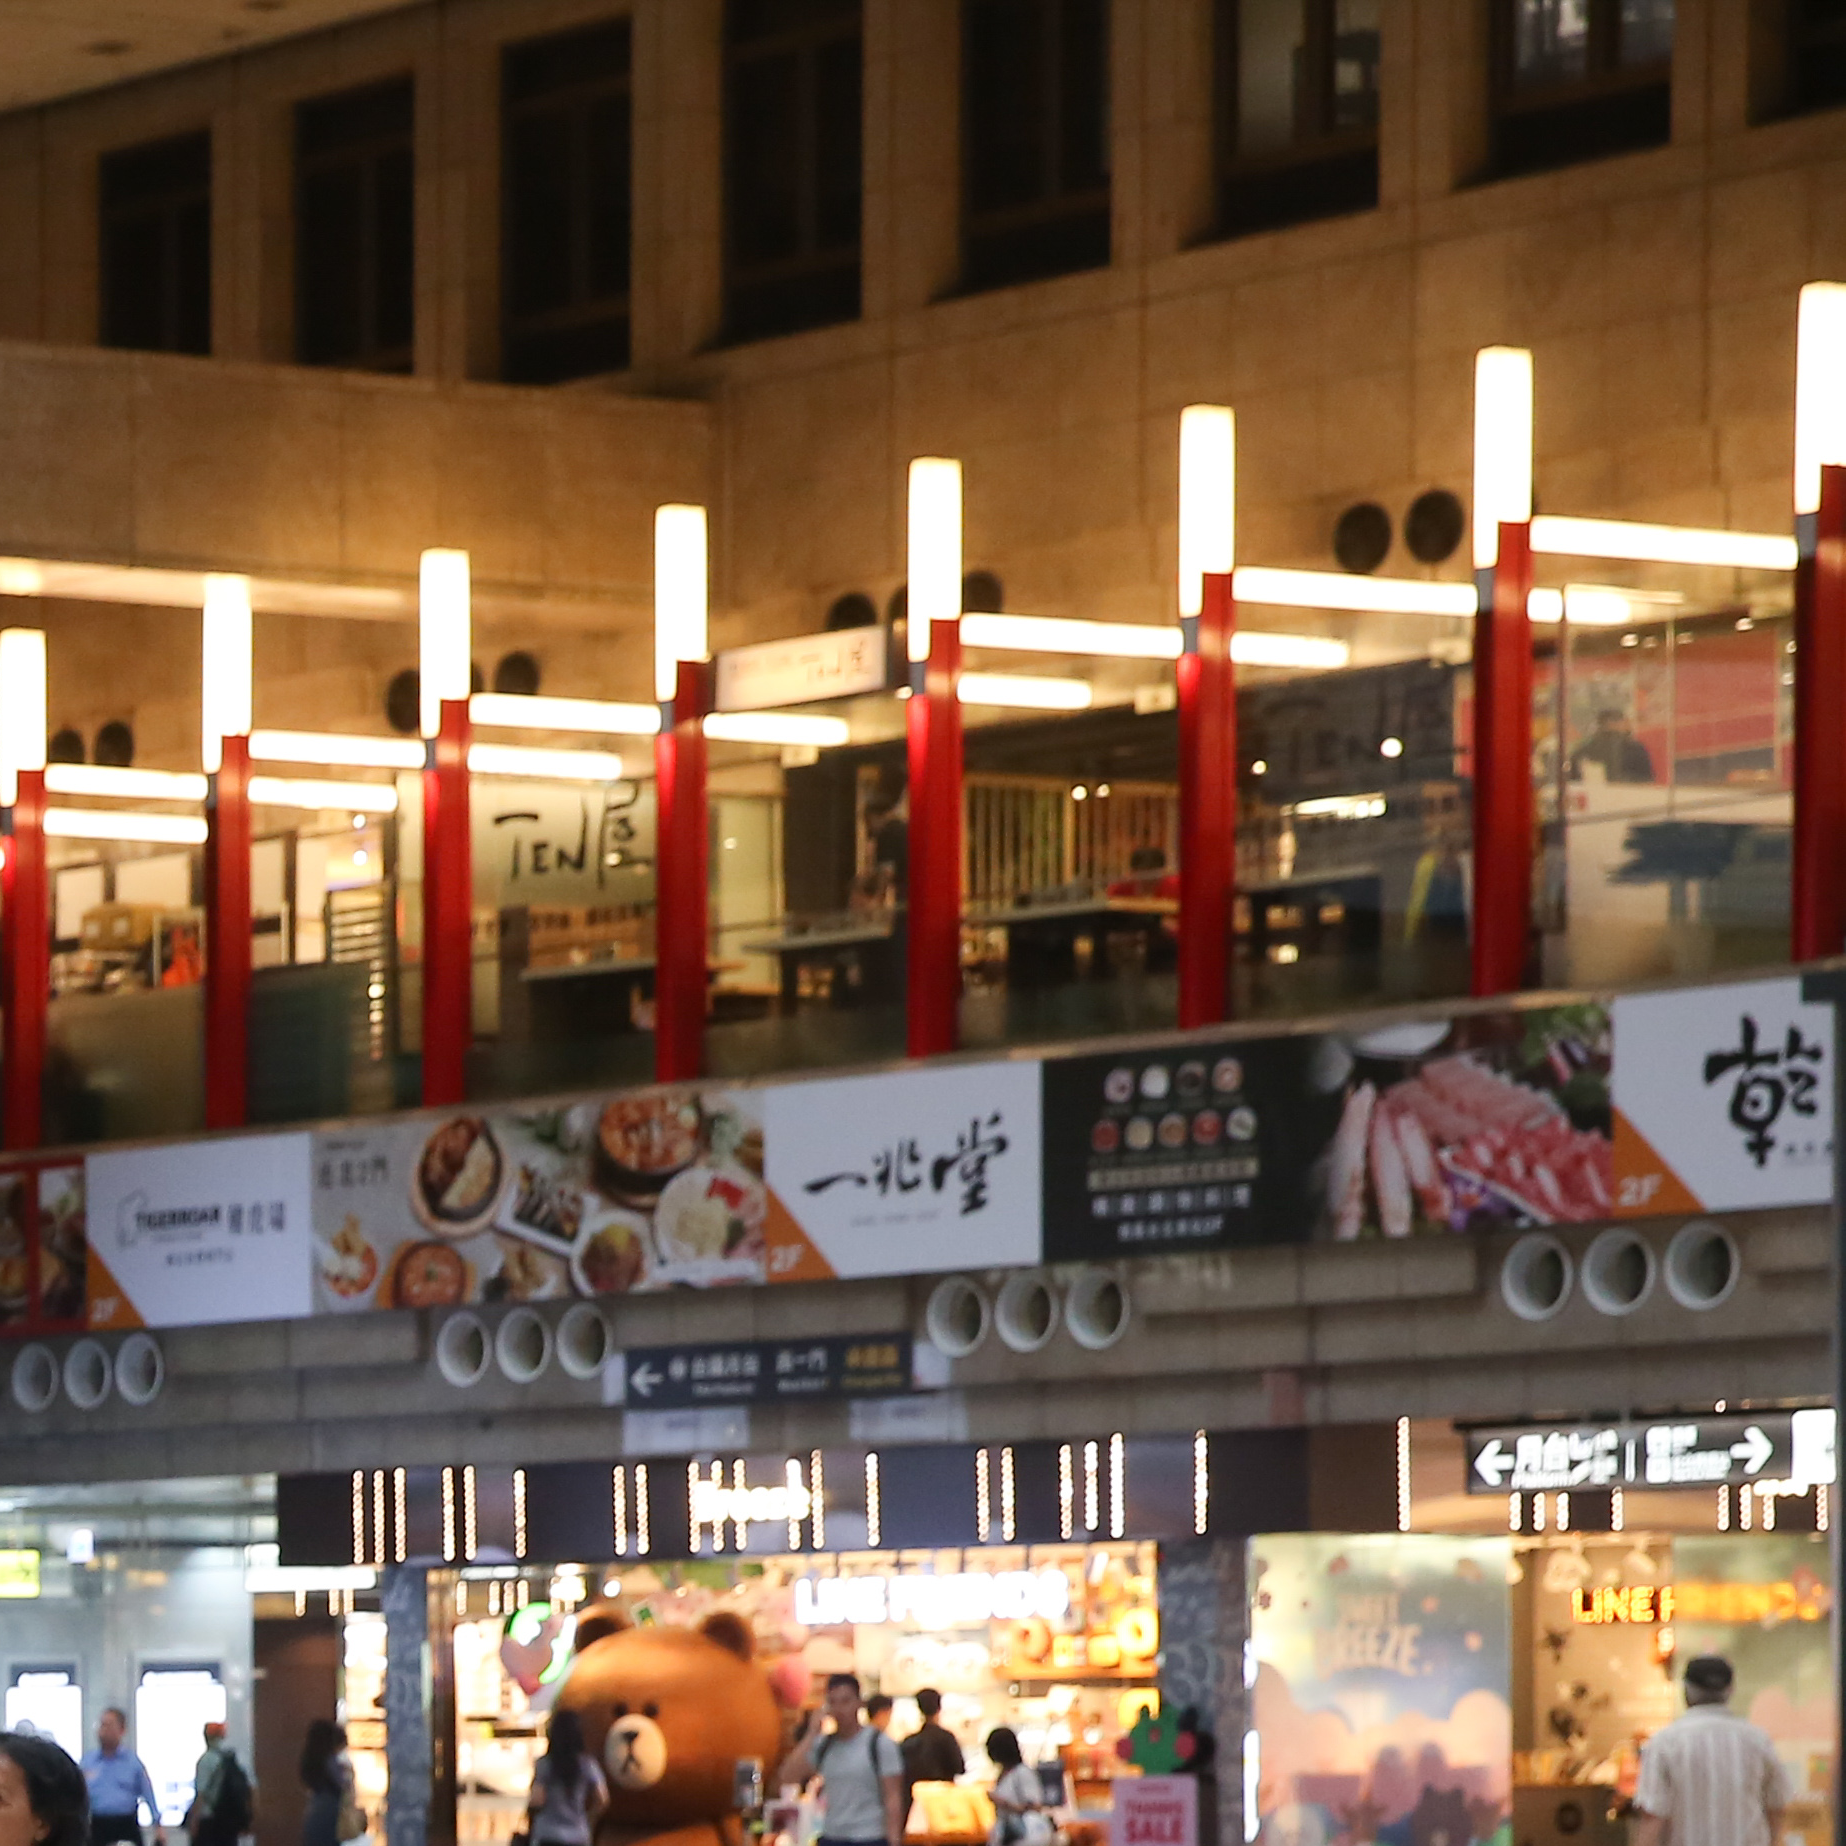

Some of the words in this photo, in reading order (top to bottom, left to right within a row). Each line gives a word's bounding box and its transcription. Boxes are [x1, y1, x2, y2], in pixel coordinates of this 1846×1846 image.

[1618, 1173, 1663, 1207] 2F
[1570, 1586, 1655, 1624] LINE
[1125, 1819, 1185, 1843] SALE
